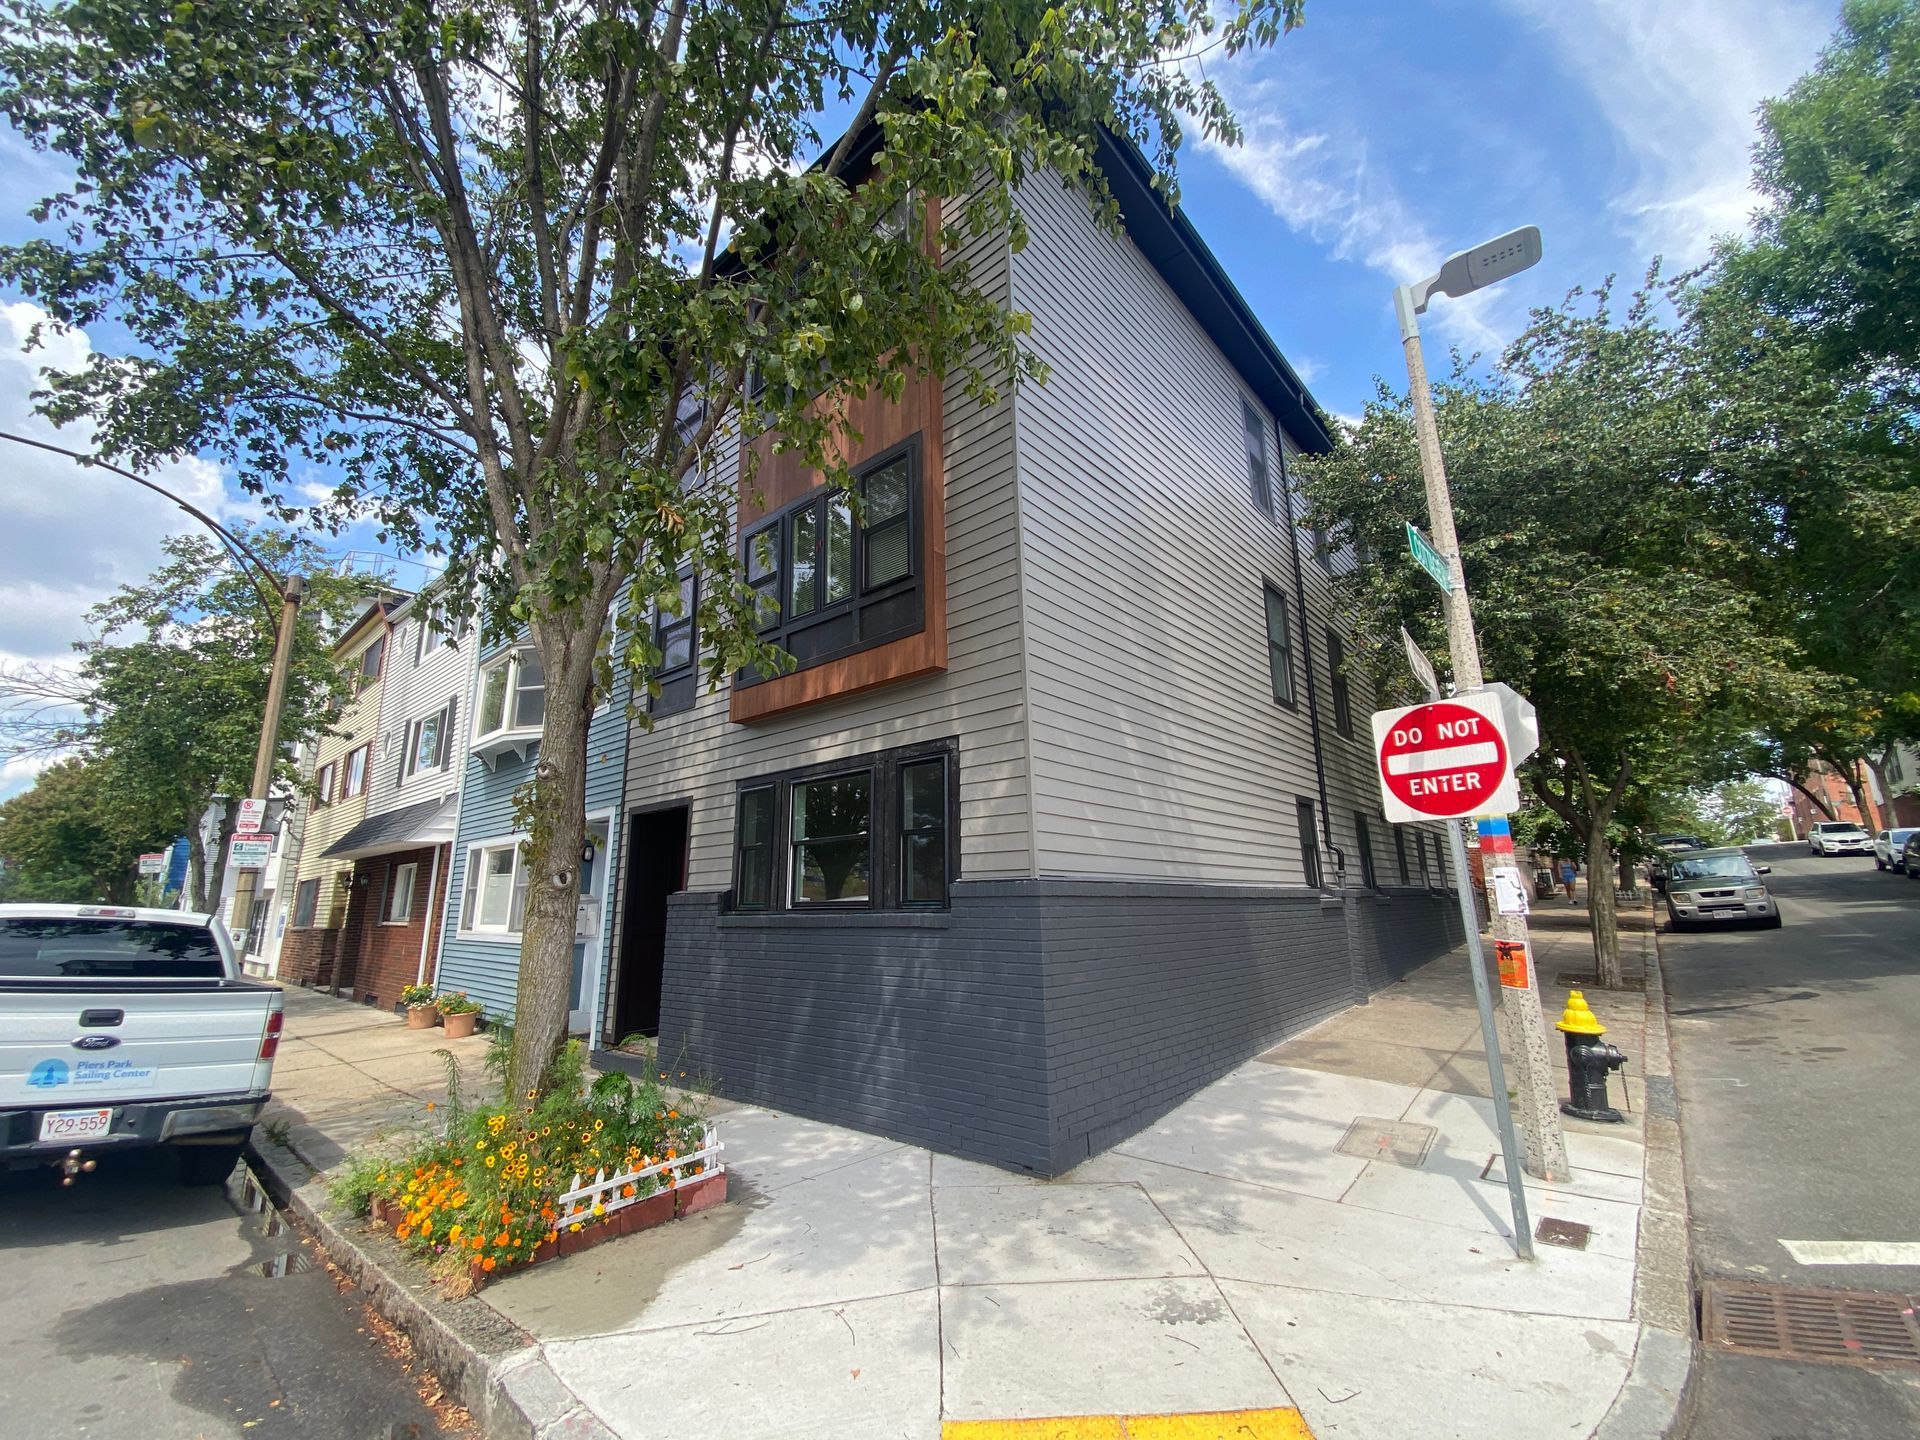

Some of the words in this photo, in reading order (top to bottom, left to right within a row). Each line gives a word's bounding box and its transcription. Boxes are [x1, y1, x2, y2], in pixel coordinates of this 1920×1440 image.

[1393, 727, 1423, 747] DO
[1438, 718, 1480, 740] NOT
[1409, 772, 1482, 796] ENTER
[82, 1037, 109, 1047] Ford
[77, 1061, 104, 1069] Piers
[107, 1060, 132, 1068] Park
[75, 1070, 110, 1080] Sailing
[113, 1069, 150, 1078] Center
